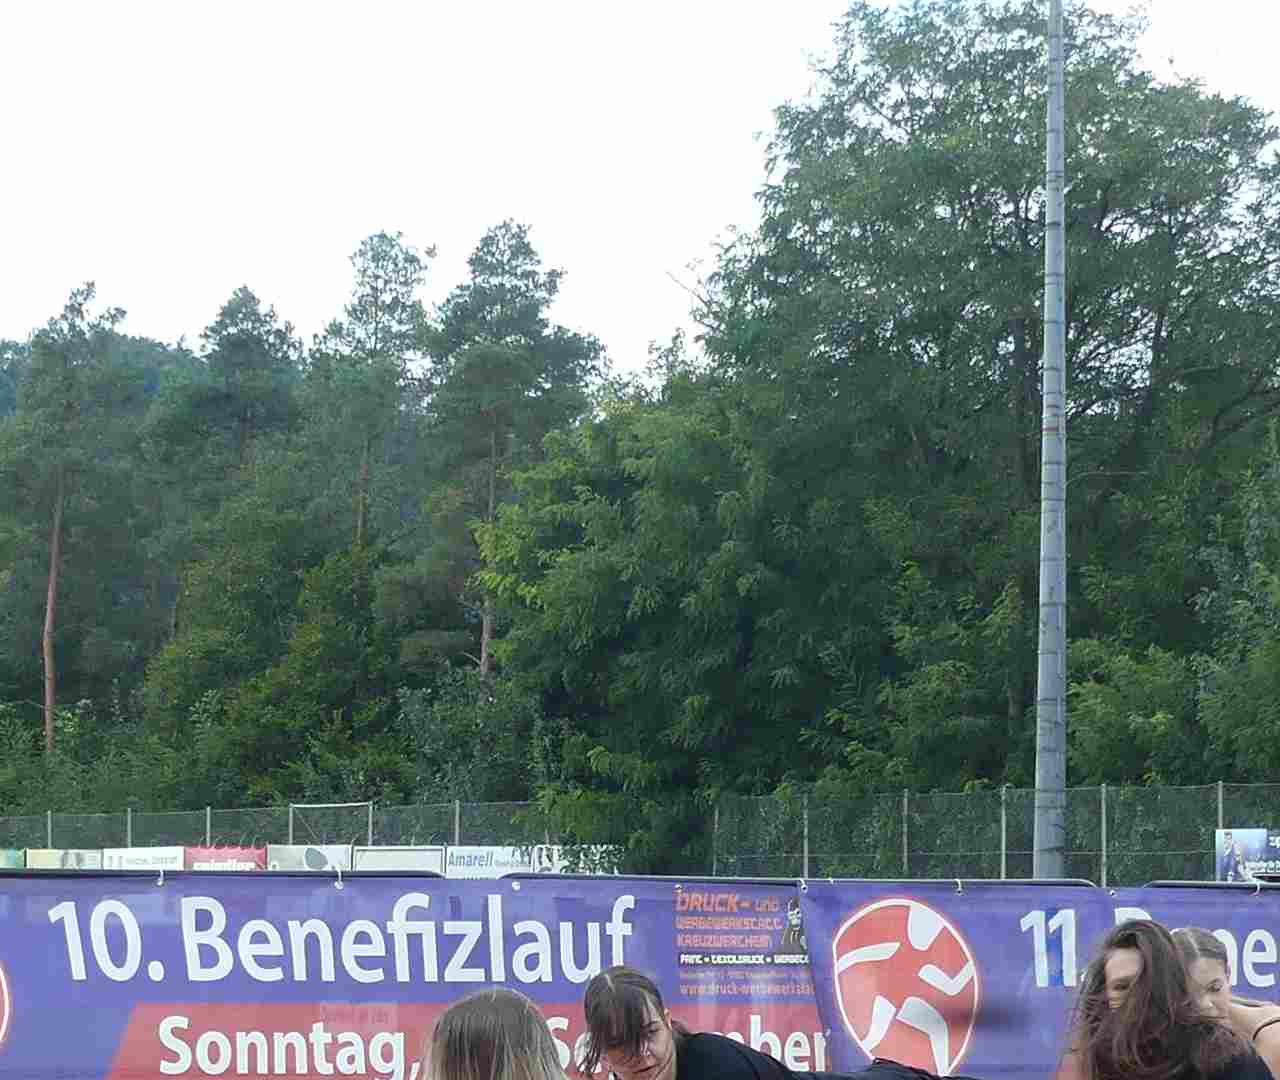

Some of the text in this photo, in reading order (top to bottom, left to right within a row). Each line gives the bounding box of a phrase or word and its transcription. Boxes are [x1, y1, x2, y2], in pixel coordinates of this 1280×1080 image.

[46, 892, 637, 985] 10. Benefizlauf
[1020, 908, 1088, 989] 11
